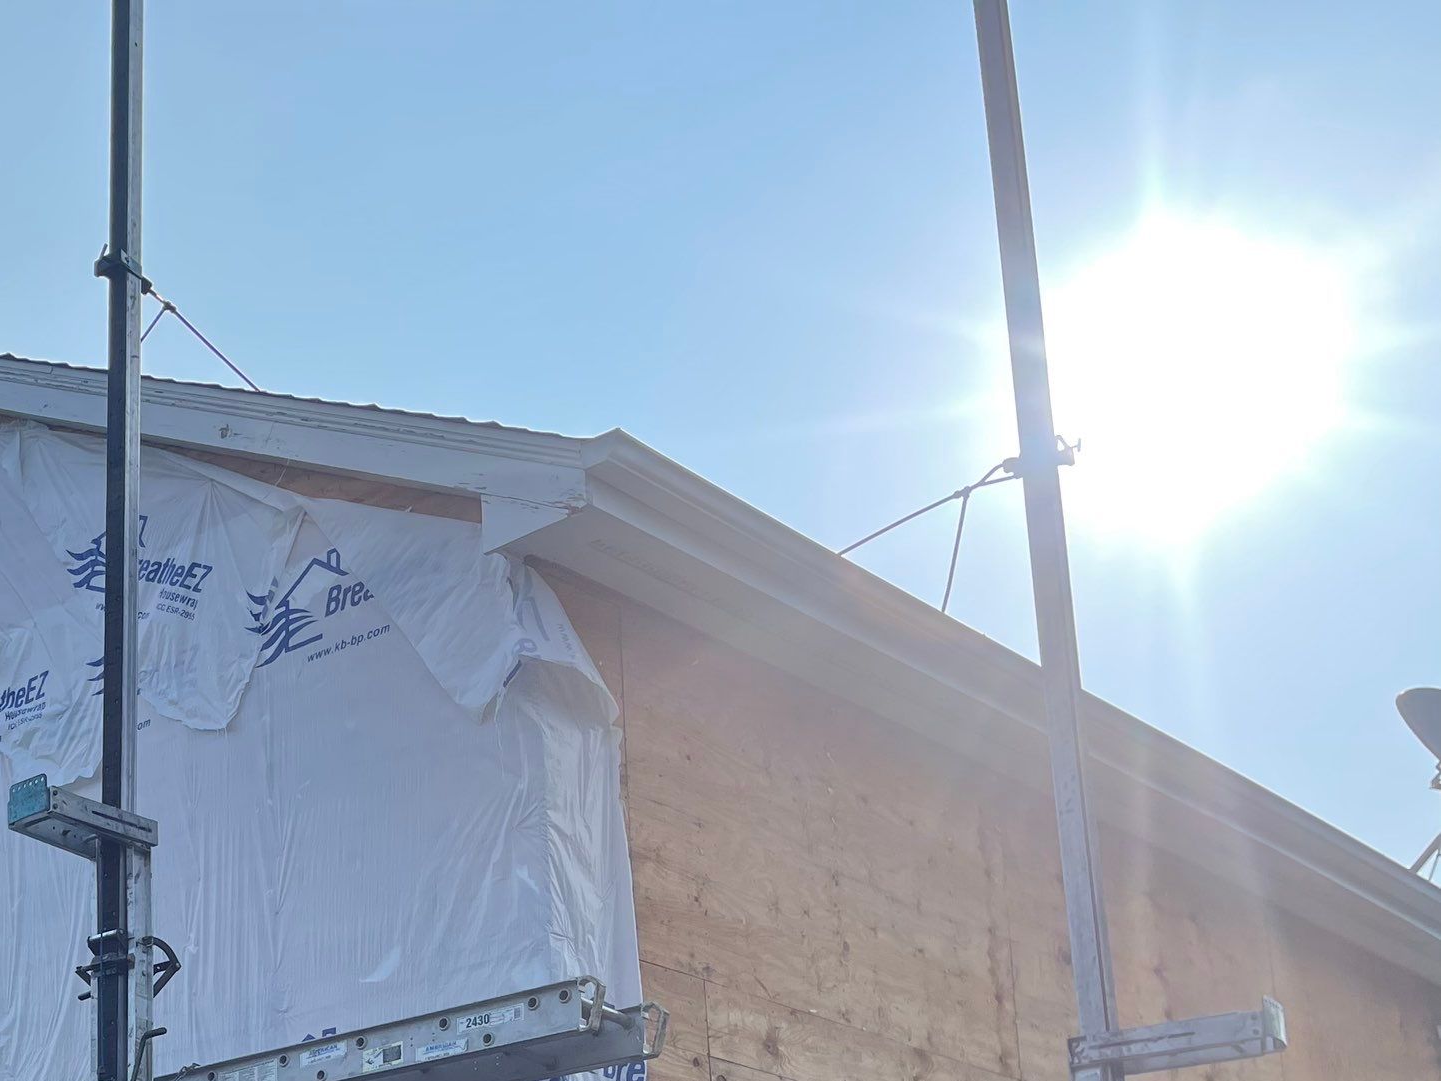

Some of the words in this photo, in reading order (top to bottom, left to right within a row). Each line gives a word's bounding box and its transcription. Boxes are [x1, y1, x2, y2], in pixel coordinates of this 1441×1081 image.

[138, 557, 214, 594] eatheEZ
[306, 624, 391, 663] www.kb-bp.com
[465, 1013, 490, 1029] 2430
